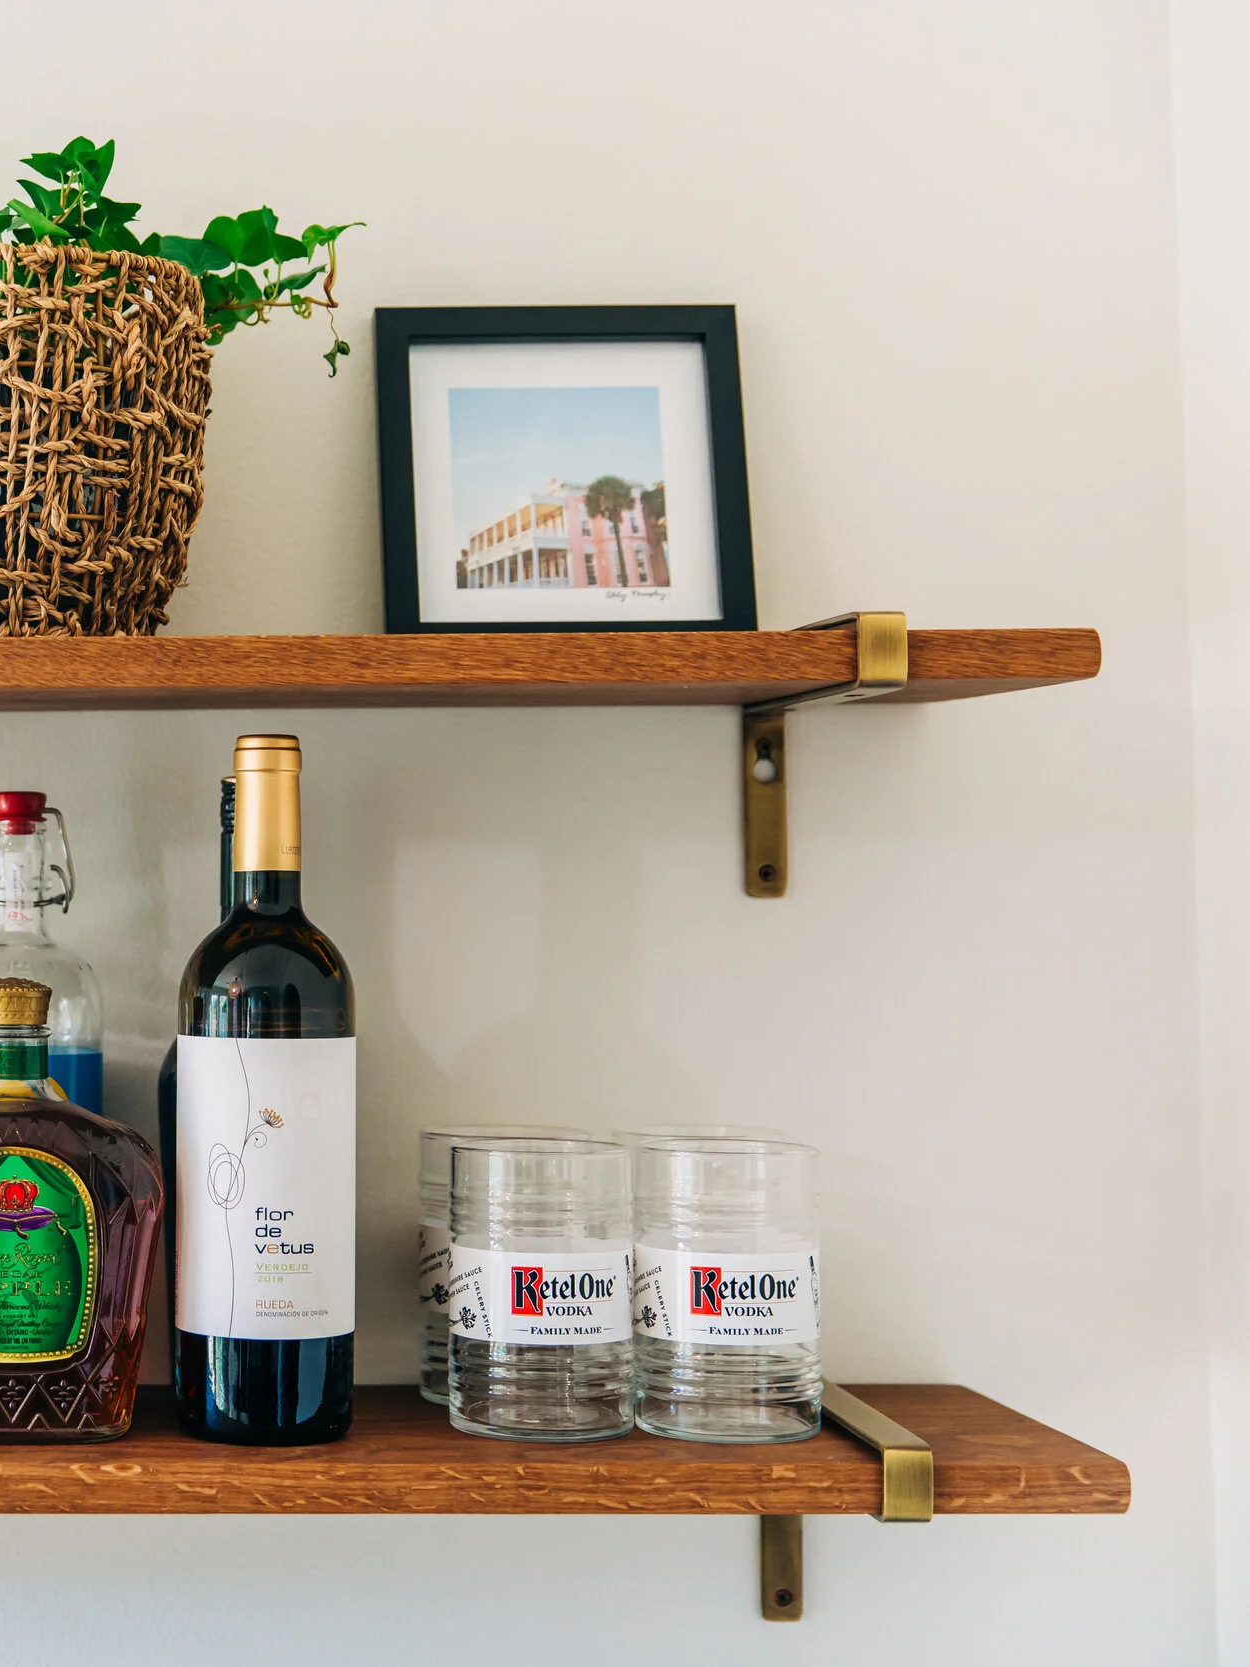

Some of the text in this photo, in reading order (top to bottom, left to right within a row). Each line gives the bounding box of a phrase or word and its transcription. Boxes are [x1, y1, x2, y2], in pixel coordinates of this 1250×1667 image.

[255, 1207, 294, 1221] flor
[255, 1224, 282, 1238] de
[255, 1242, 315, 1255] vetus
[256, 1263, 309, 1271] VERDEJO
[464, 1266, 483, 1279] SAUCE
[645, 1265, 662, 1278] SAUCE
[257, 1275, 284, 1283] 2018
[455, 1283, 470, 1295] SAUCE
[513, 1269, 615, 1313] Ketel One
[691, 1269, 797, 1313] Ketel One
[255, 1299, 294, 1310] RUEDA
[473, 1281, 493, 1339] CELERY STICK
[546, 1305, 593, 1317] VODKA
[654, 1279, 673, 1338] CELERY STICK
[724, 1306, 774, 1318] VODKA
[530, 1326, 602, 1336] FAMILY MADE
[709, 1326, 784, 1336] FAMILY MADE
